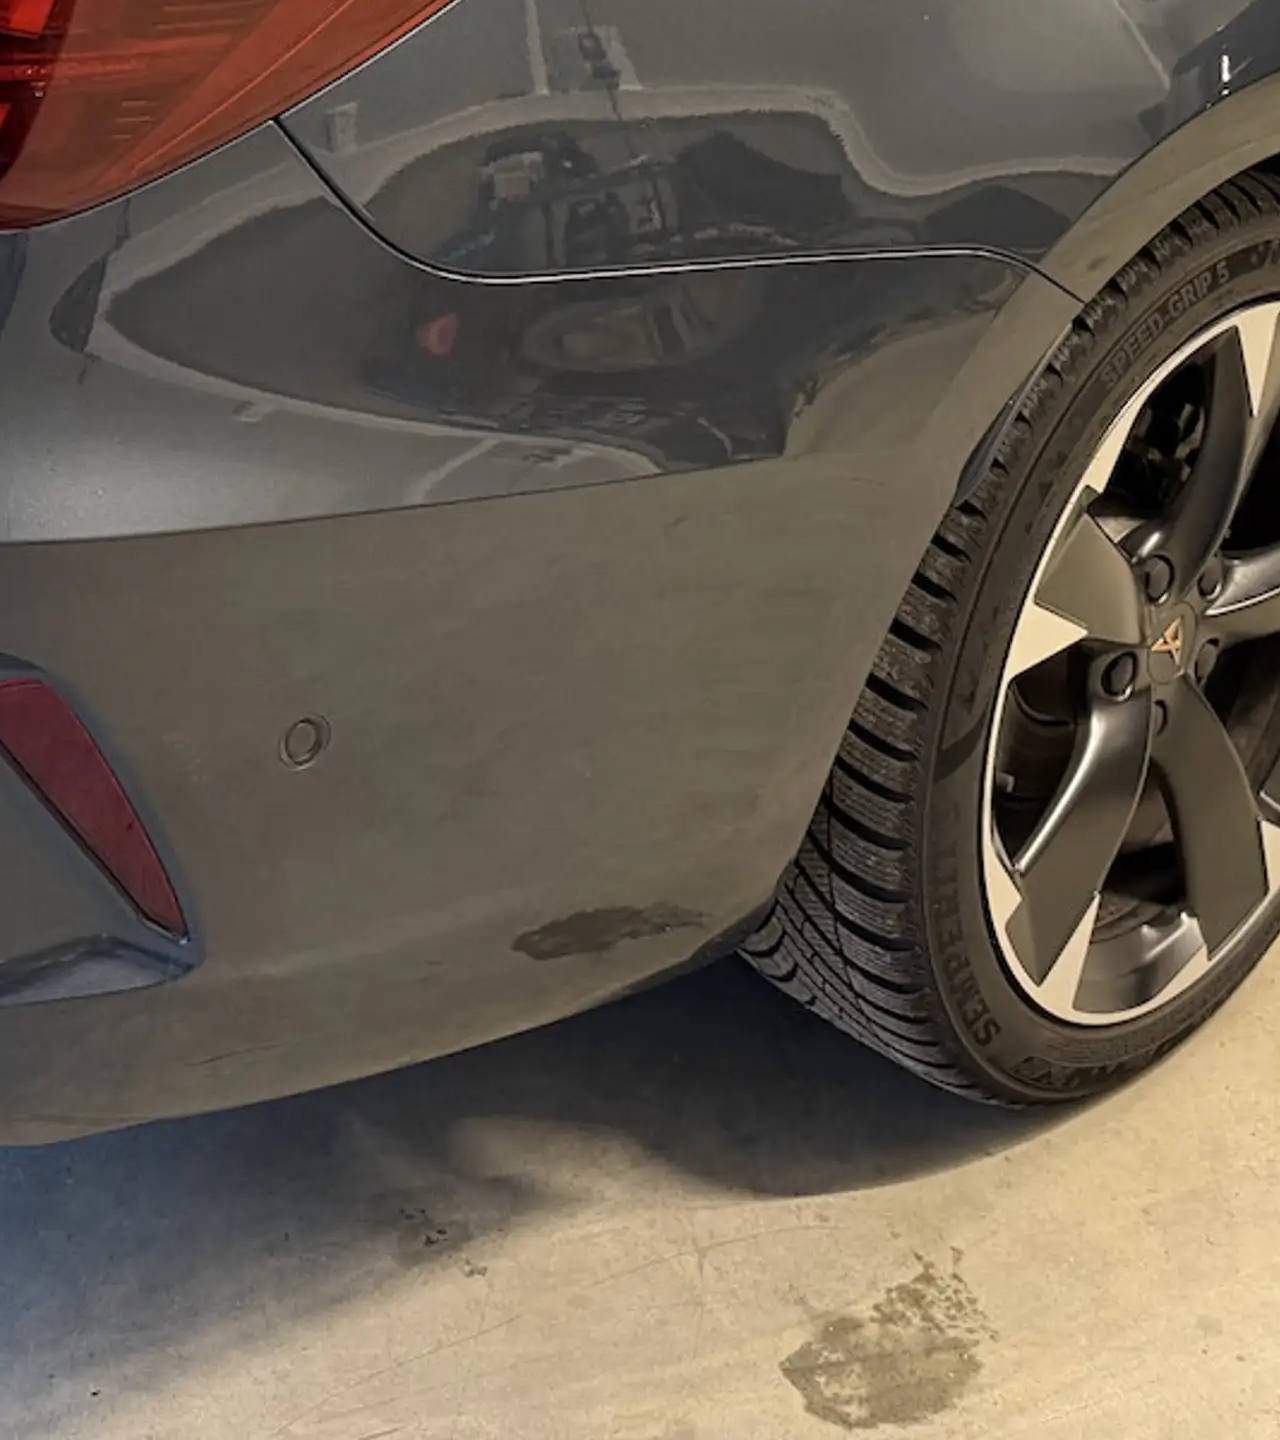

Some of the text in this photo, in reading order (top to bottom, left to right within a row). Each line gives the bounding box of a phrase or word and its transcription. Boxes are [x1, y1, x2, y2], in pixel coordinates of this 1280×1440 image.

[1101, 261, 1231, 389] SPEED-GRIP 5
[929, 832, 1002, 1048] SEMPERIT
